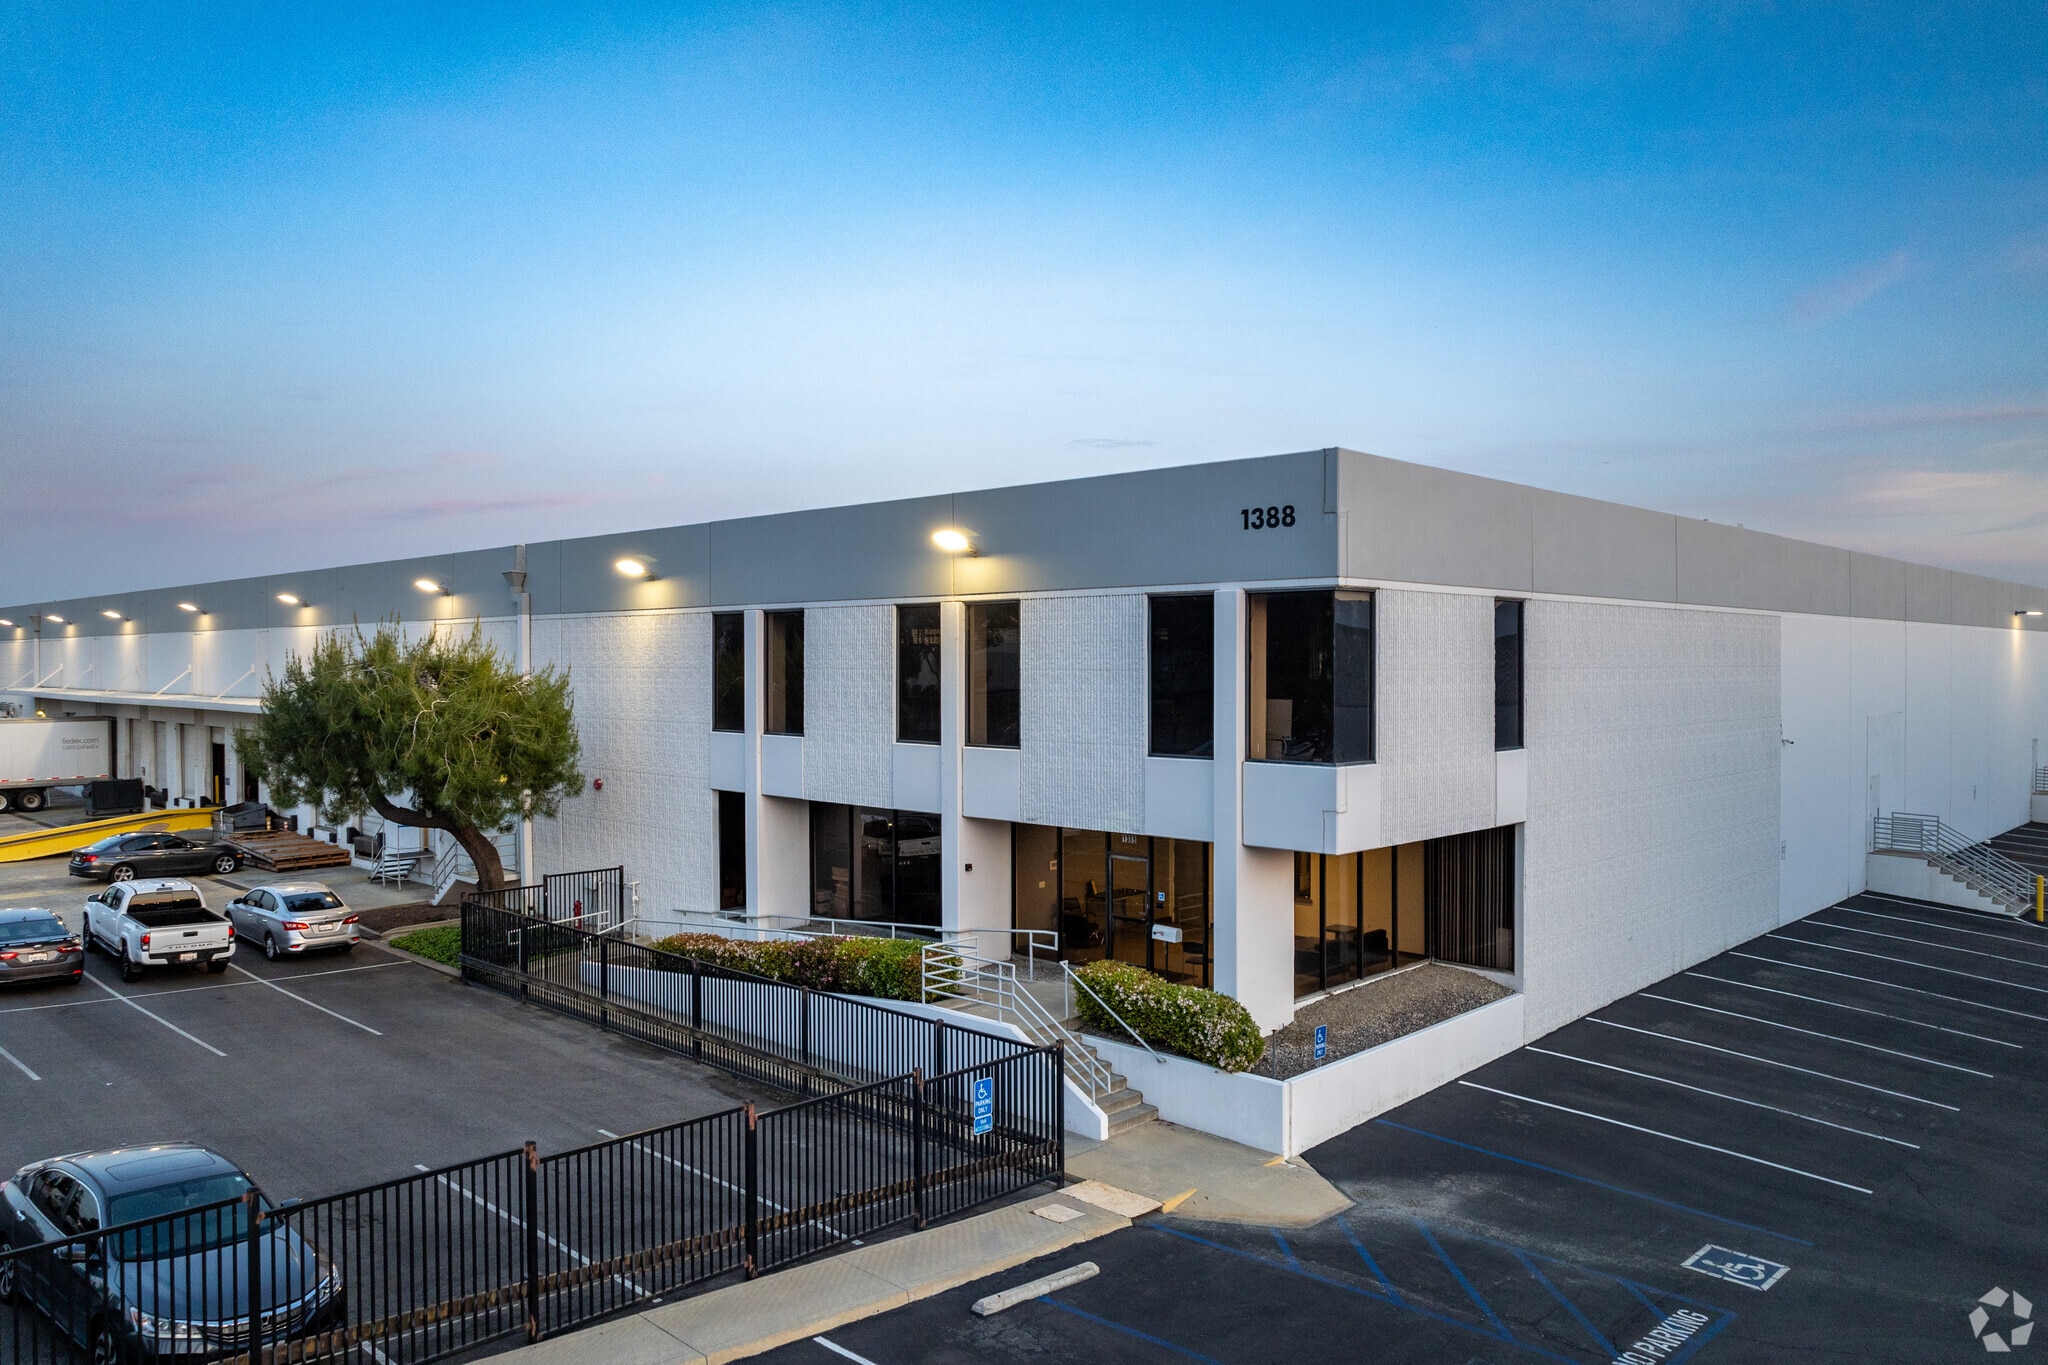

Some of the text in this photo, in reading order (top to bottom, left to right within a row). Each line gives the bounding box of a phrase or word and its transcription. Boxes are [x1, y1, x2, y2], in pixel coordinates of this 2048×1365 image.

[1241, 505, 1296, 530] 1388
[978, 1106, 988, 1114] ONLY
[1631, 1309, 1709, 1358] PARKING
